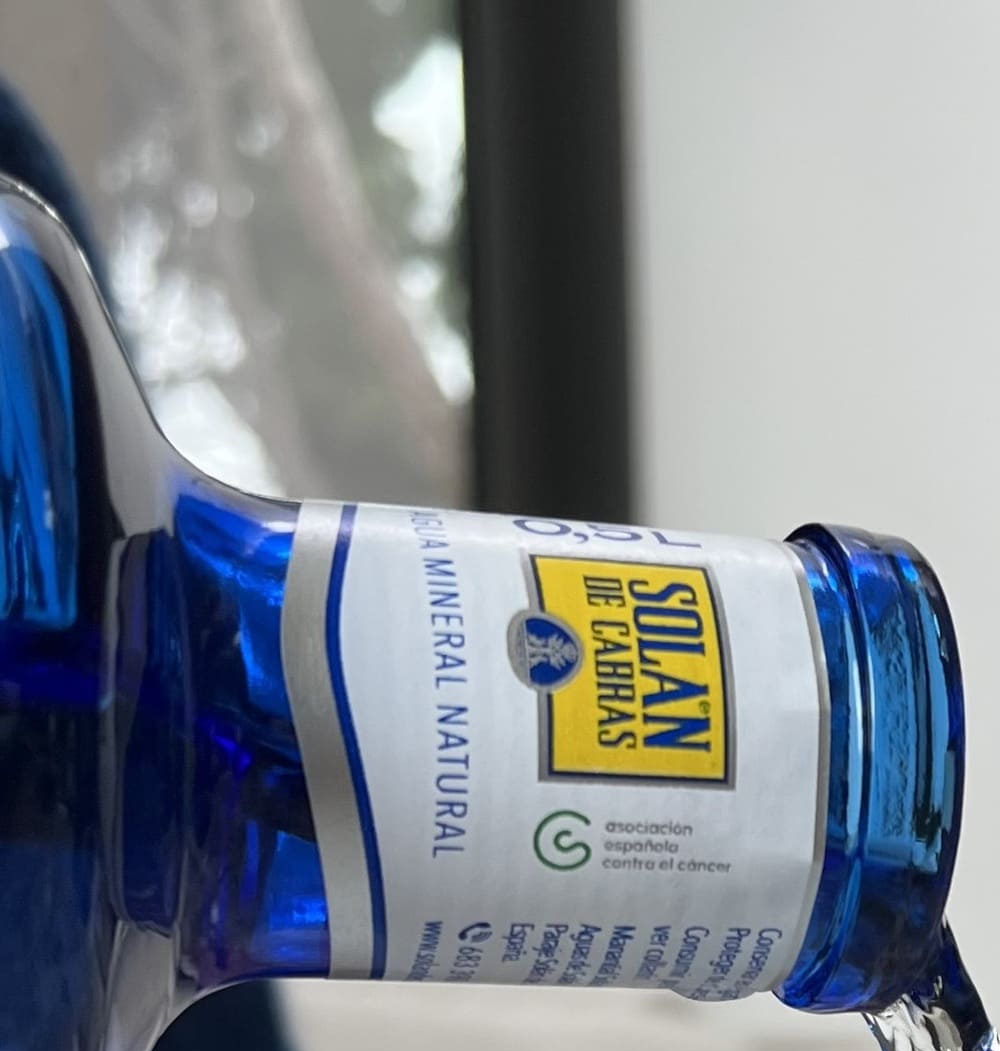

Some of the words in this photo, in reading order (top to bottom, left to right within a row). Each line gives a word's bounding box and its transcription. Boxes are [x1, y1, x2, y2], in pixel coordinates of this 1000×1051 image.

[411, 511, 450, 550] AGUA
[583, 575, 627, 609] DE
[423, 557, 467, 690] MINERAL
[591, 620, 637, 750] CABRAS
[628, 579, 712, 753] SOLAN
[432, 704, 470, 859] NATURAL
[603, 839, 680, 855] española
[605, 819, 693, 837] asociación
[602, 856, 655, 871] contra
[658, 857, 674, 871] el
[677, 857, 732, 874] cáncer
